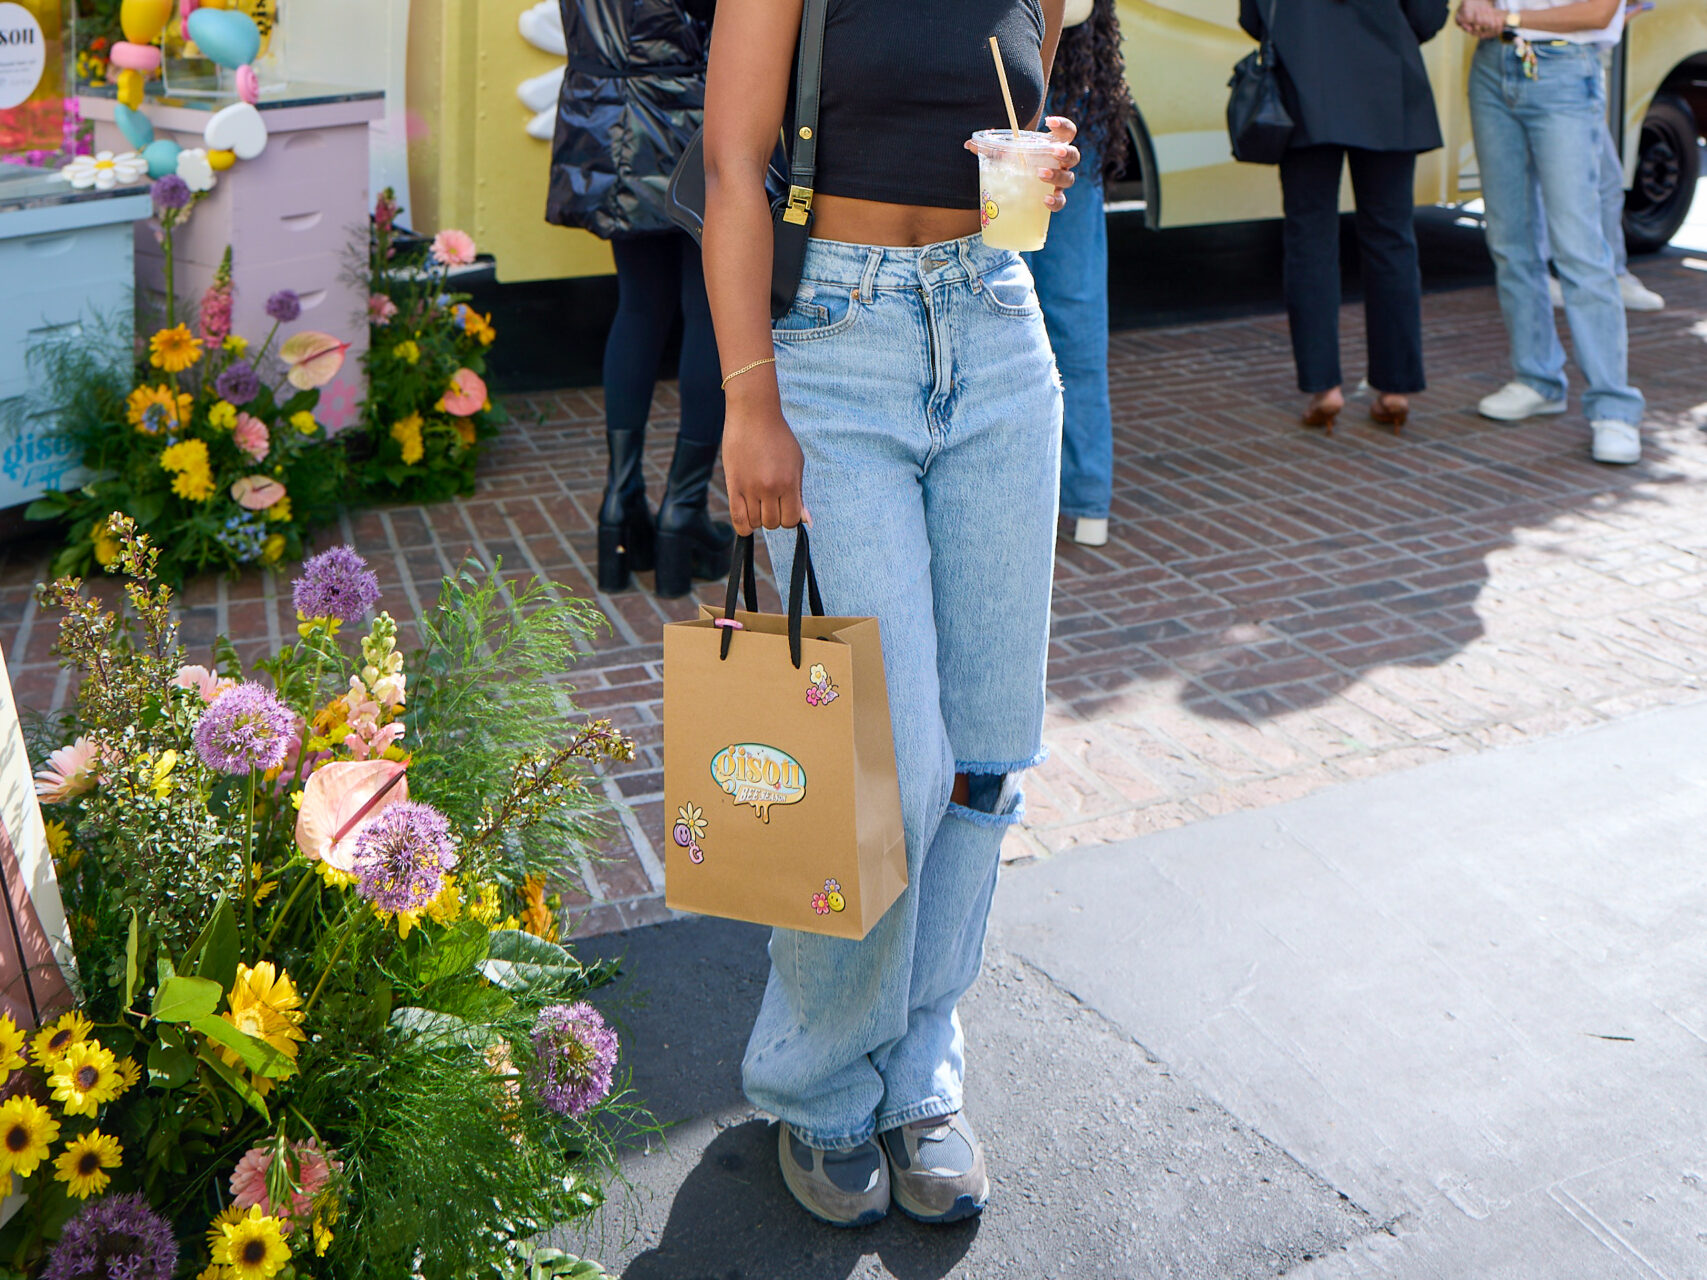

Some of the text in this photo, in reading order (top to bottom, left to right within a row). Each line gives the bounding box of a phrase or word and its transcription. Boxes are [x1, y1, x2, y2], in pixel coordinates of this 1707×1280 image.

[2, 432, 84, 480] giso
[715, 744, 800, 794] gisou
[738, 787, 761, 802] BEE
